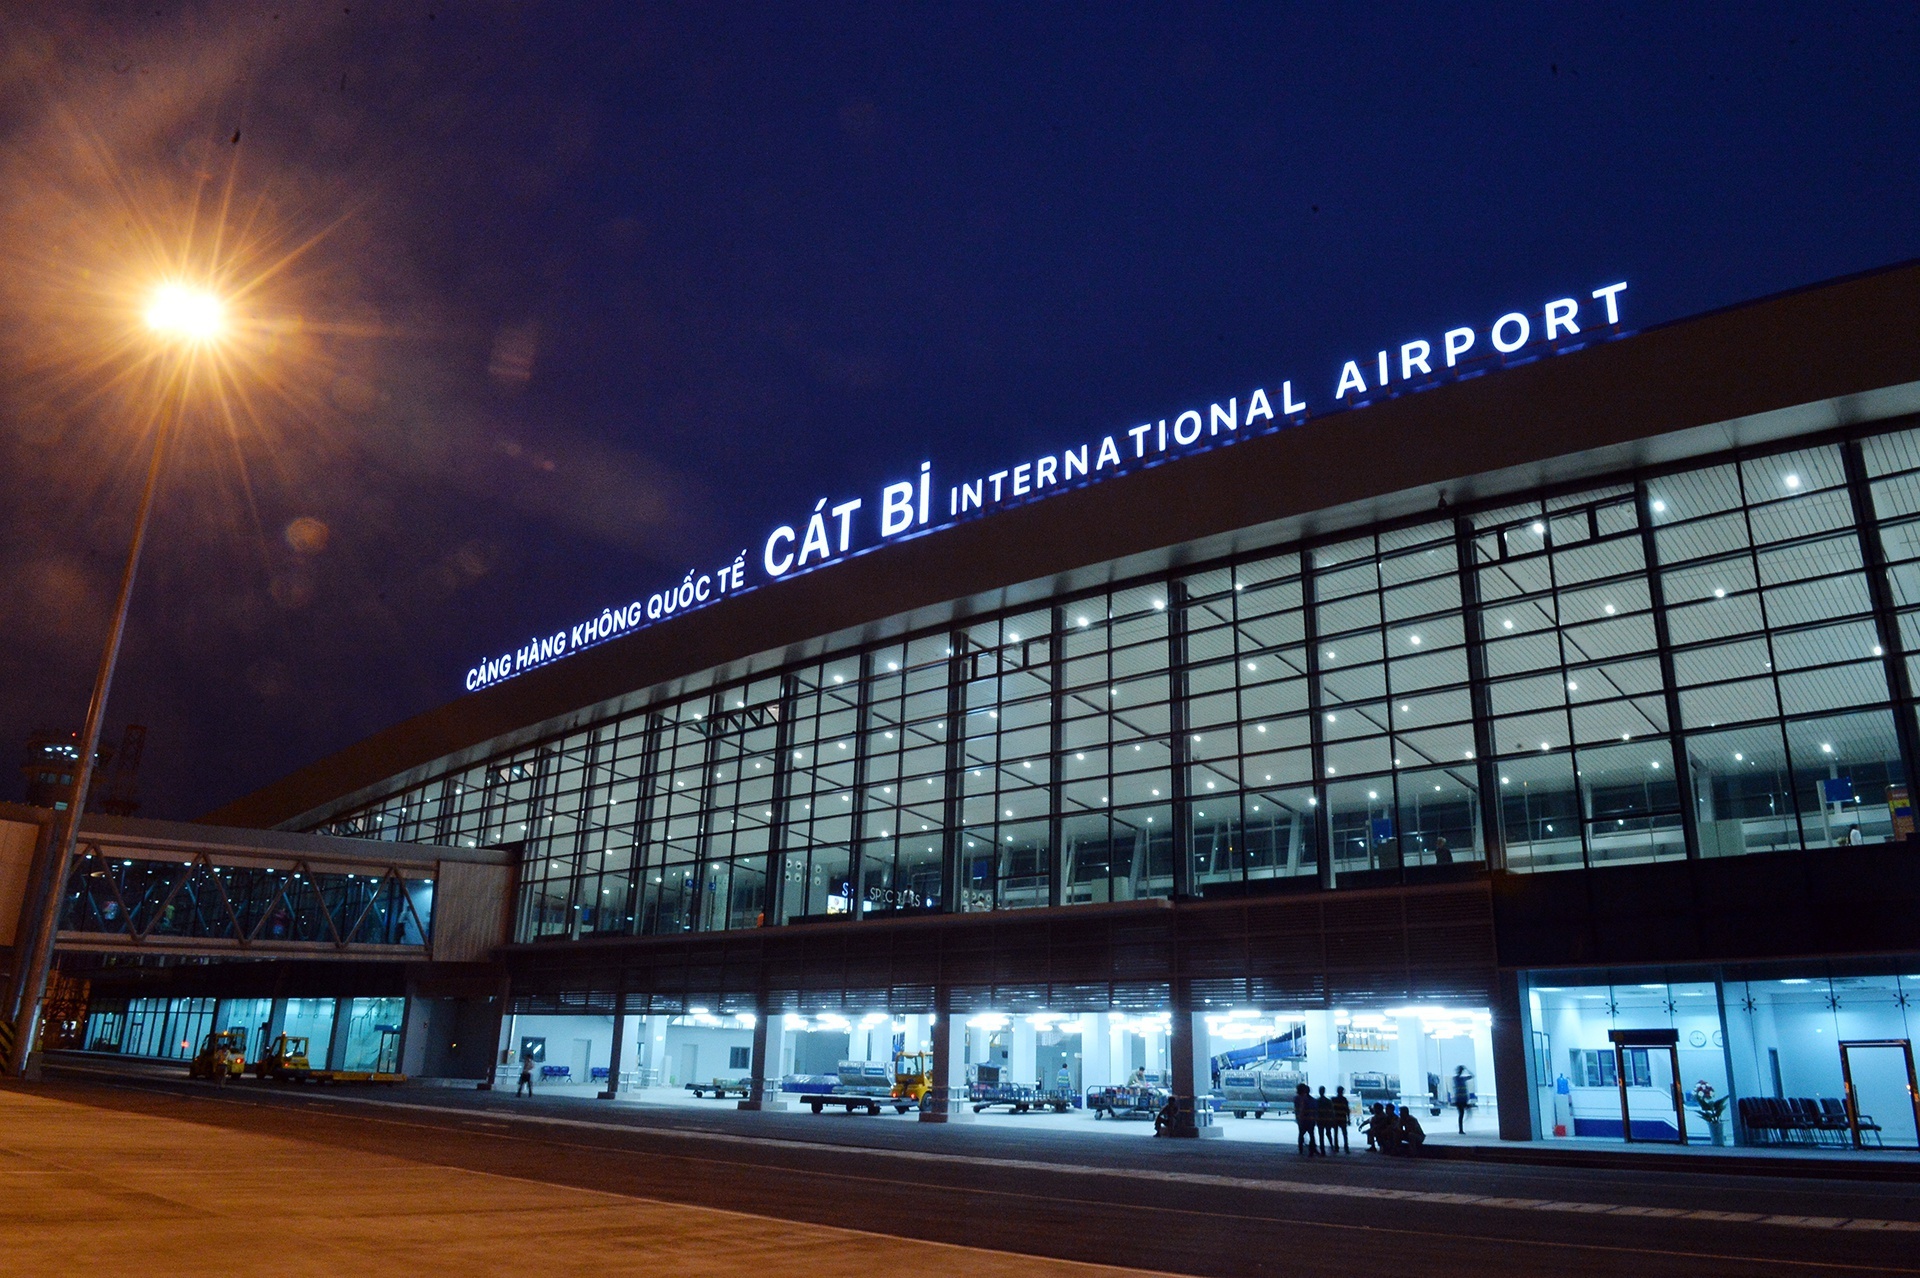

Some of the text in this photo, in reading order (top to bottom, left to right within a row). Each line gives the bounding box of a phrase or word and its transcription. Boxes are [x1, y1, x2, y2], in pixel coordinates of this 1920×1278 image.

[465, 653, 512, 691] CẢNG
[515, 632, 567, 671] HÀNG
[571, 602, 642, 649] KHÔNG
[647, 568, 711, 619] QUỐC
[717, 548, 747, 594] TẾ
[763, 497, 862, 577] CÁT
[950, 380, 1306, 516] INTERNATIONAL
[1335, 281, 1628, 400] AIRPORT
